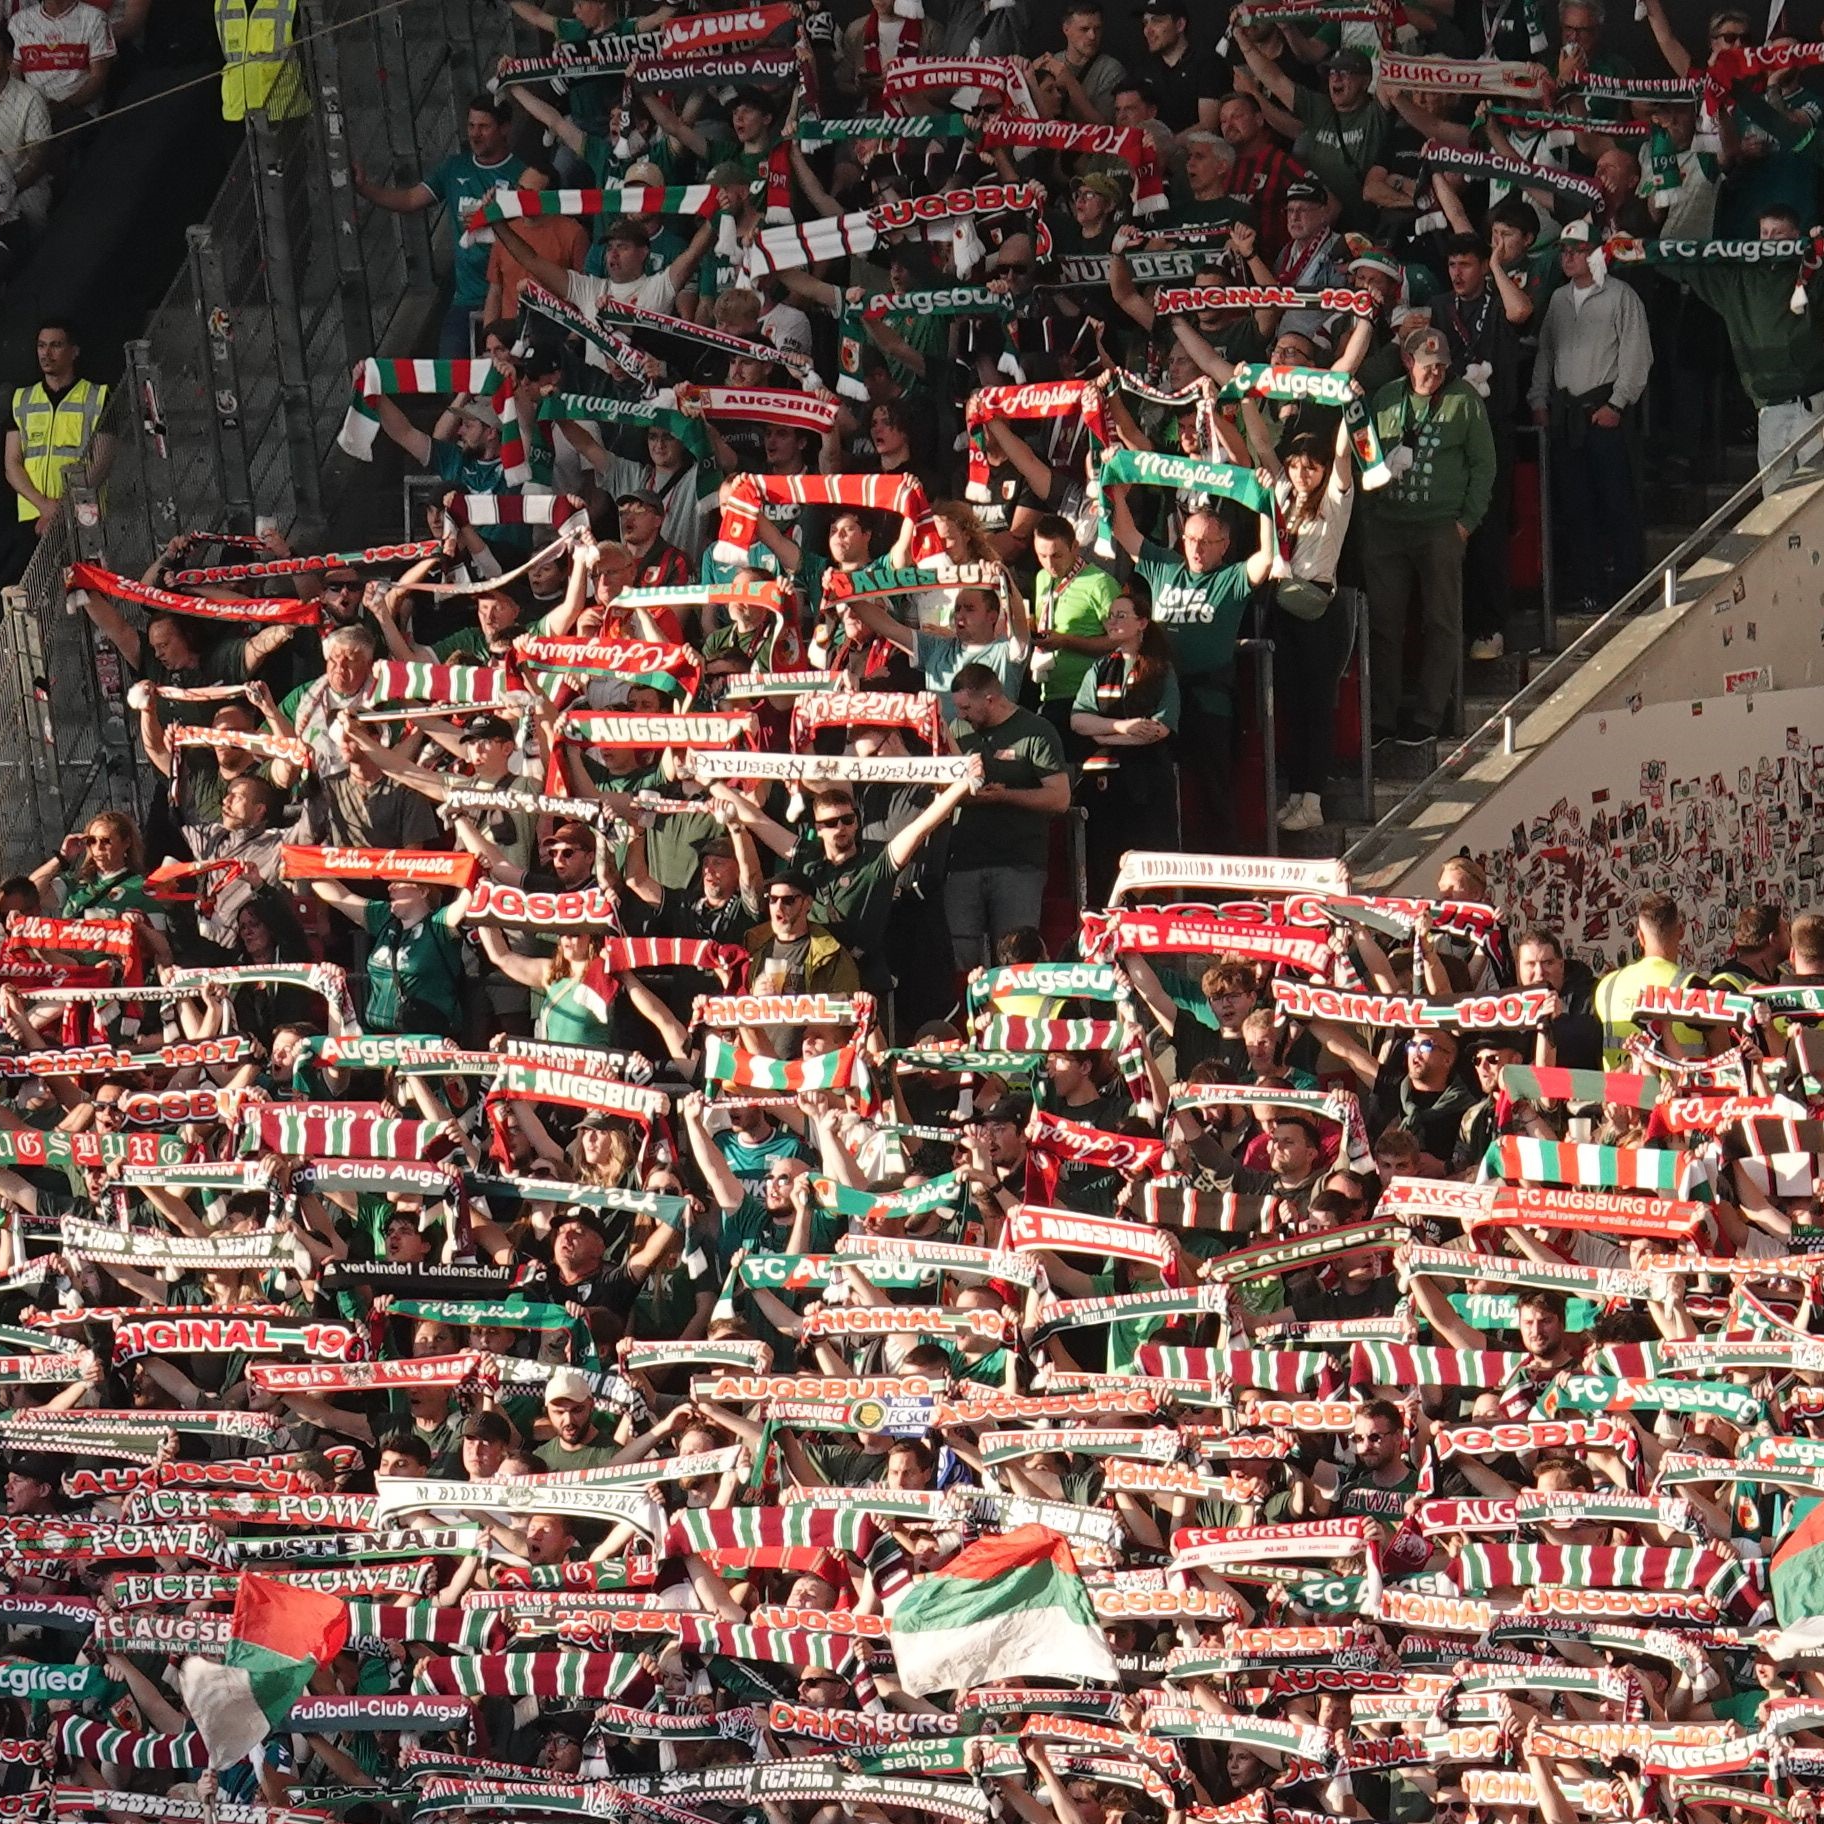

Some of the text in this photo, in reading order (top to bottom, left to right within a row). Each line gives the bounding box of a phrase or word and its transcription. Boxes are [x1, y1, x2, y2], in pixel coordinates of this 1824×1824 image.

[1660, 239, 1698, 259] FC
[1134, 449, 1234, 489] Mitglied
[177, 539, 440, 584] ORIGINAL 1907
[322, 847, 454, 875] Bella Augusta
[1141, 860, 1276, 880] FUSSBALLCLUB AUGSBURG
[1121, 925, 1327, 965] FC AUGSBURG
[1459, 989, 1545, 1024] 1907
[163, 1039, 239, 1064] 1907
[1517, 1189, 1671, 1215] FC AUGSBURG 07
[341, 1260, 510, 1281] verbindet Leidenschaft
[717, 1377, 929, 1398] AUGSBURG
[1568, 1376, 1759, 1425] FC Augsburg
[235, 1528, 459, 1560] LUSTENAU
[94, 1614, 122, 1639] FC
[290, 1700, 392, 1720] Fußball-Club
